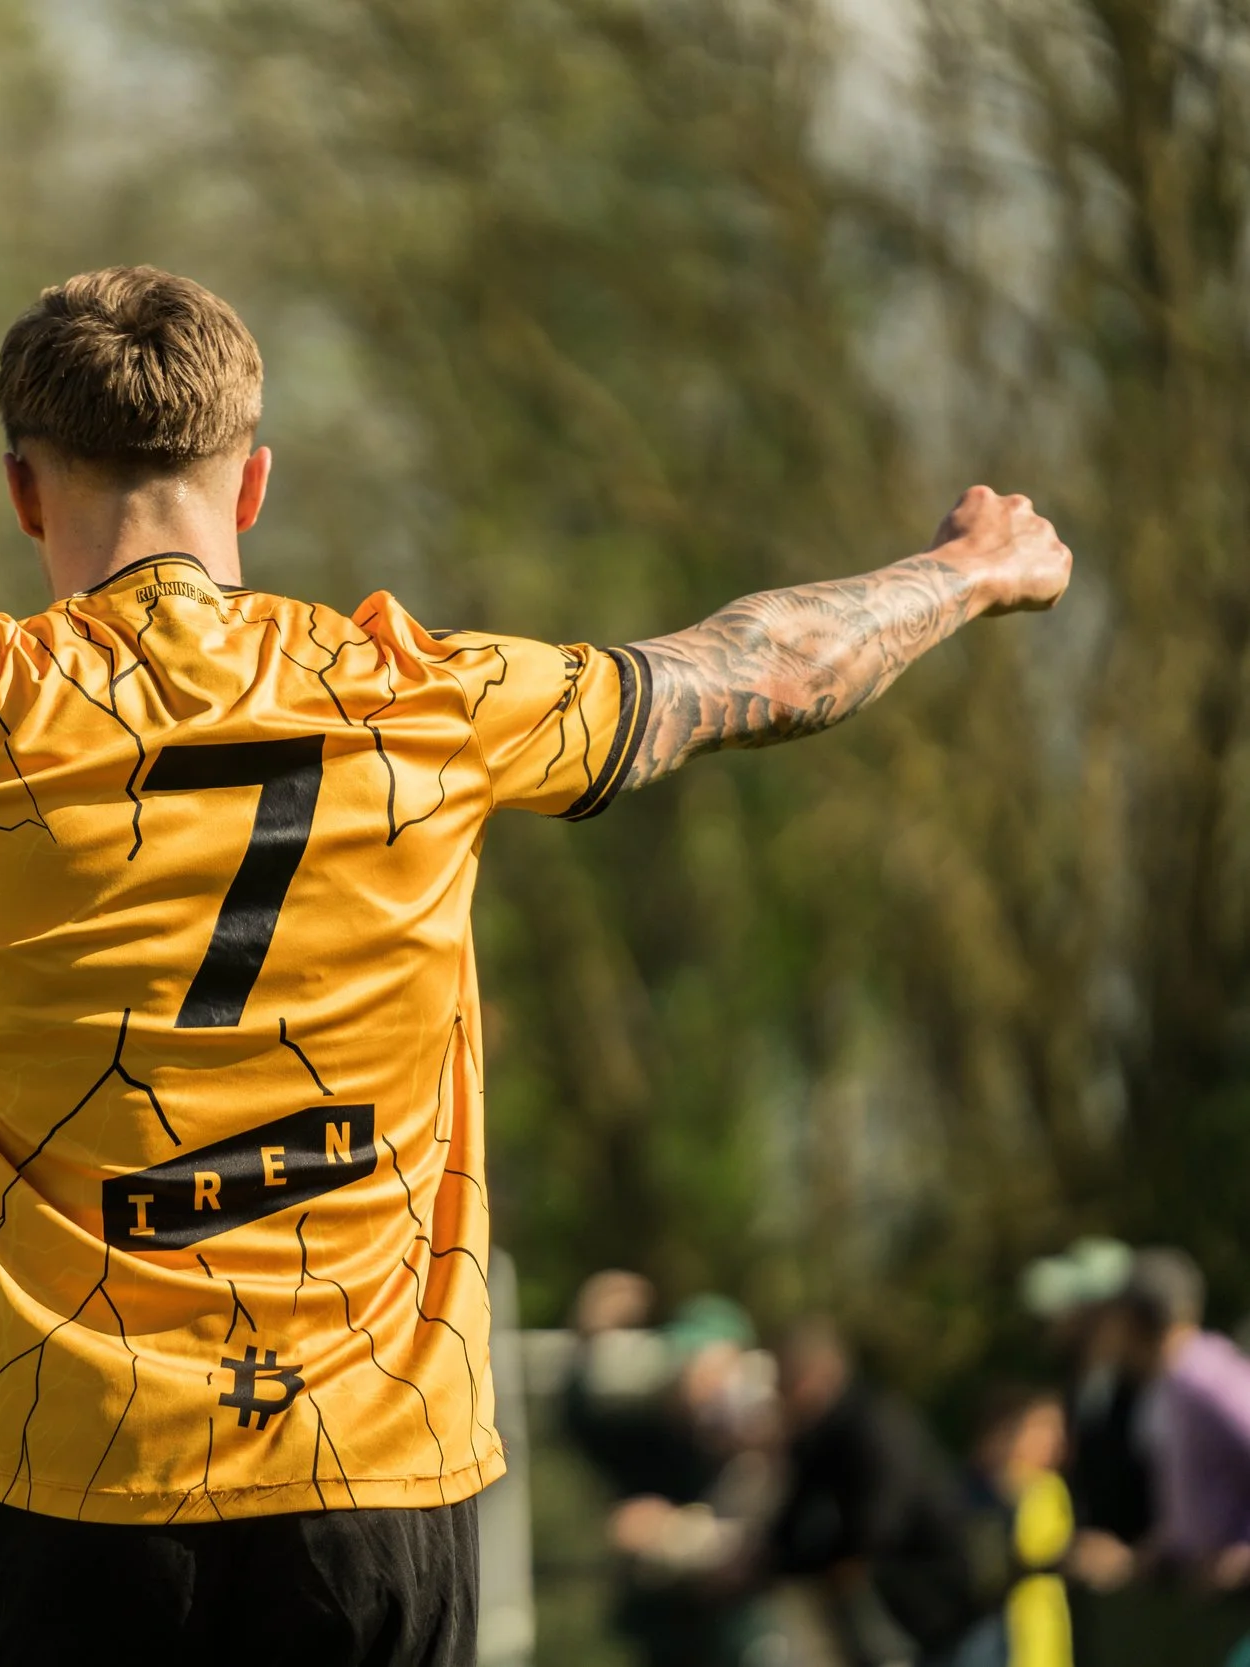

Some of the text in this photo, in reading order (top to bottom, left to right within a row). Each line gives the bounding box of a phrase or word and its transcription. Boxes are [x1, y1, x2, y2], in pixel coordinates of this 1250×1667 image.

[136, 581, 196, 603] RUNNING
[141, 734, 326, 1028] 7
[128, 1122, 352, 1236] IREN
